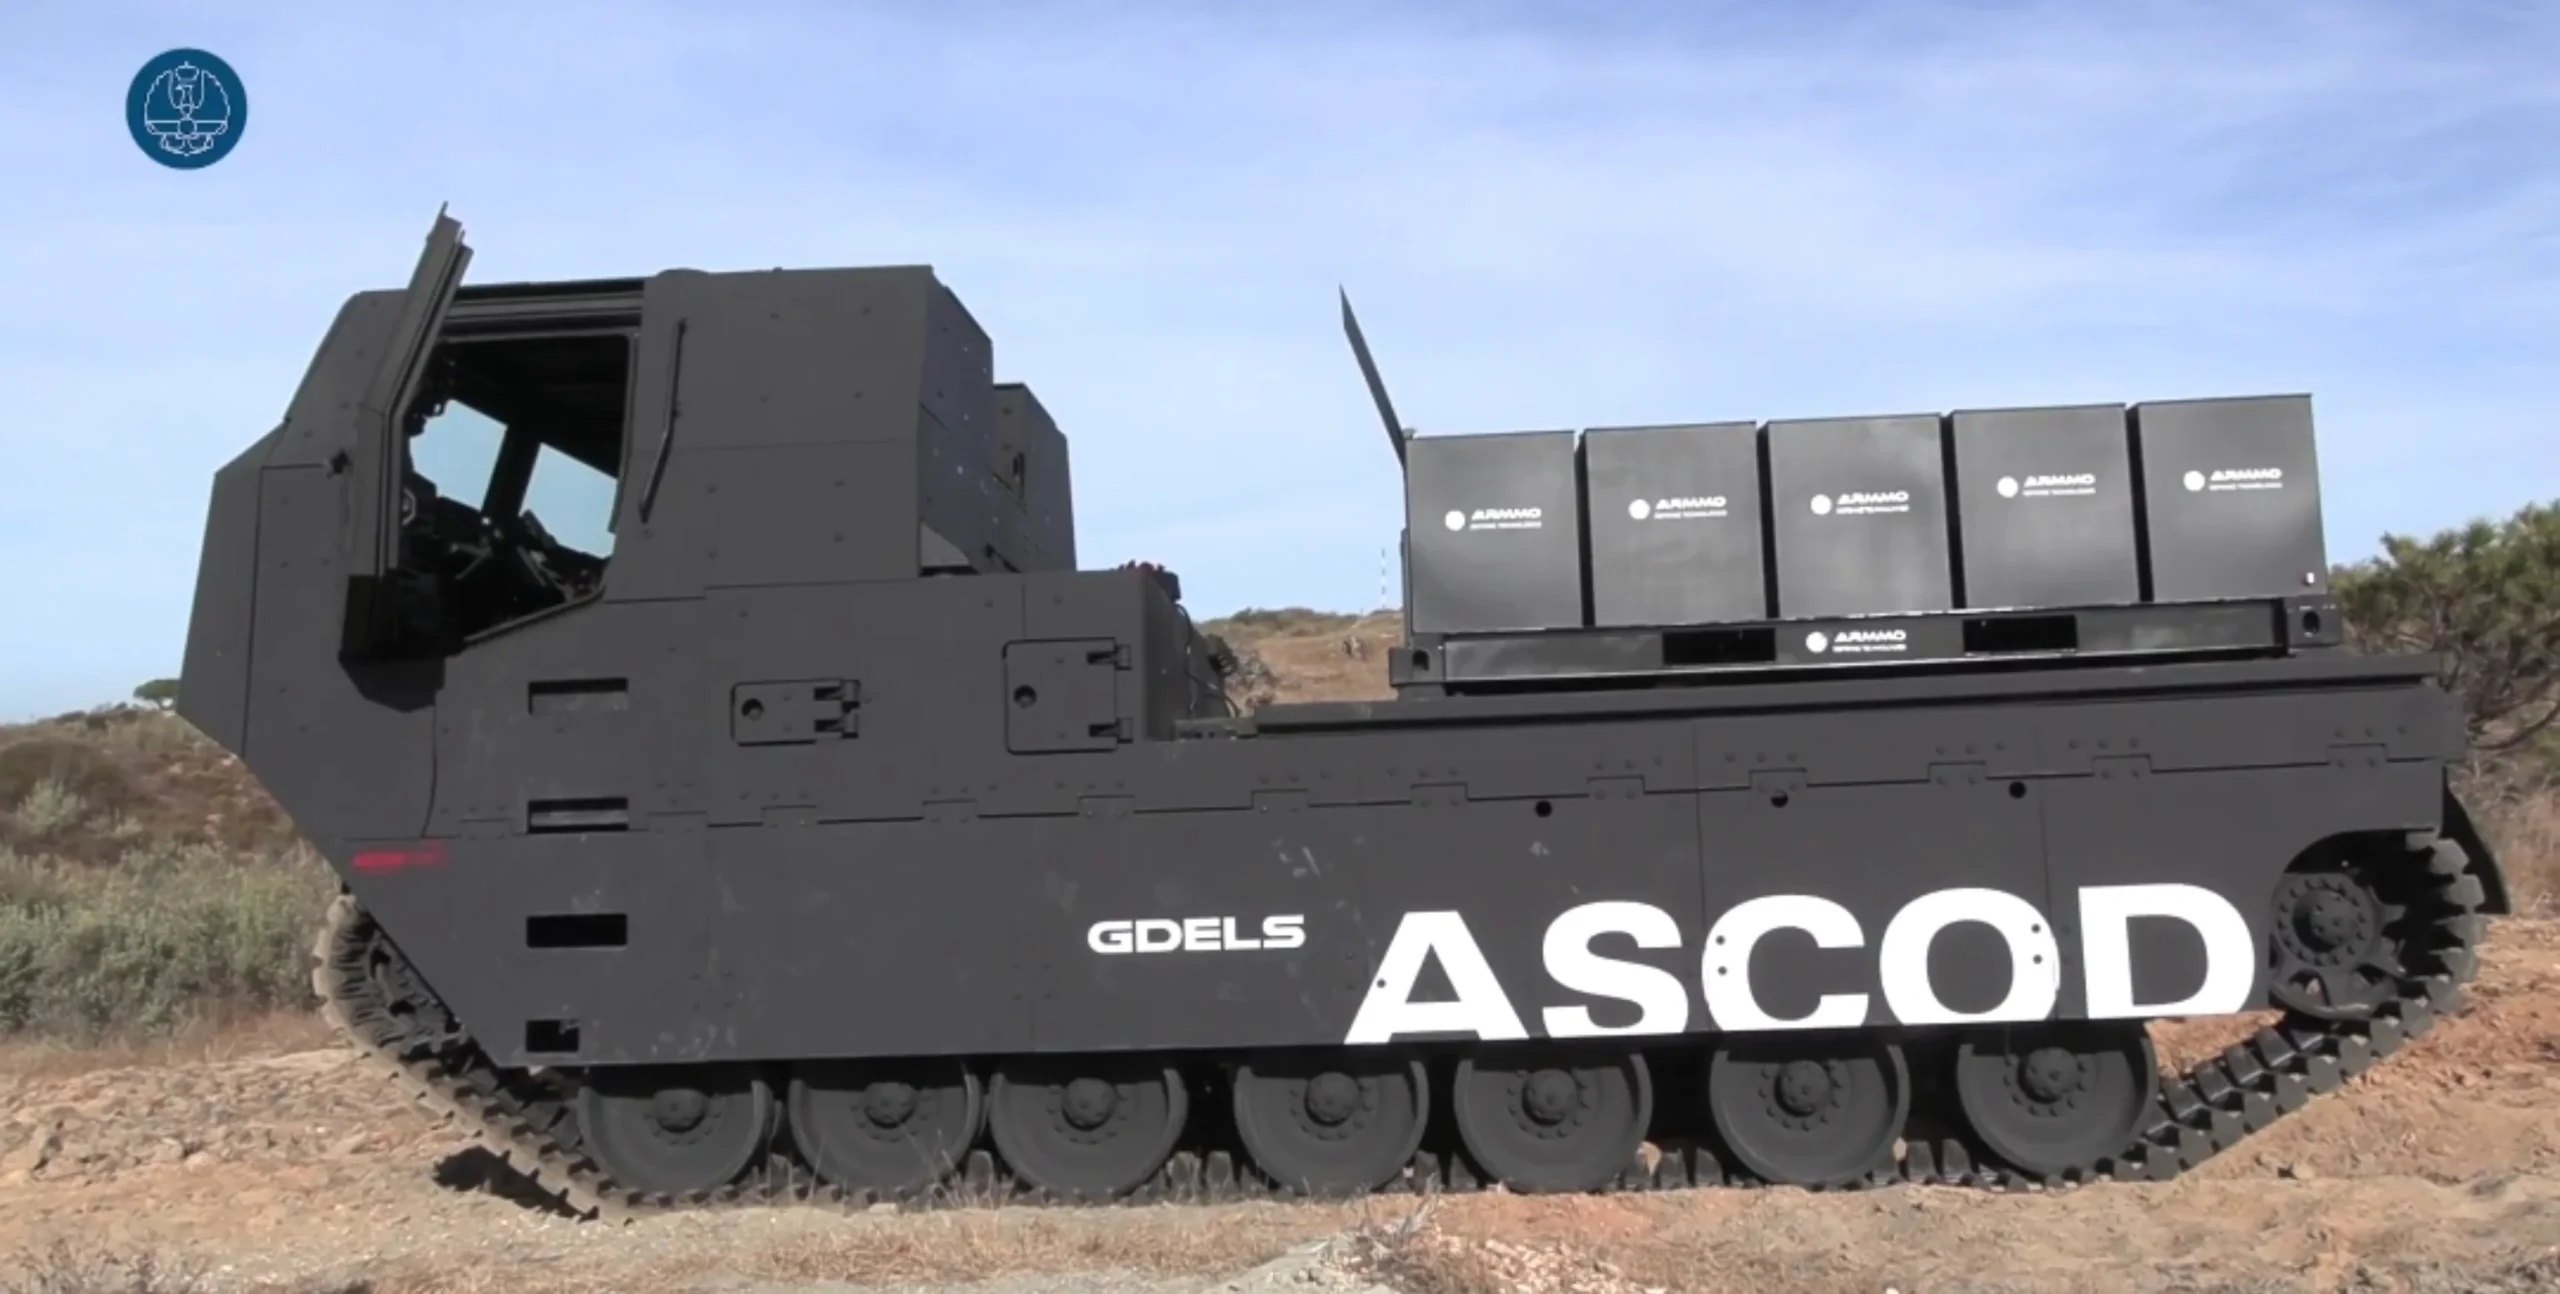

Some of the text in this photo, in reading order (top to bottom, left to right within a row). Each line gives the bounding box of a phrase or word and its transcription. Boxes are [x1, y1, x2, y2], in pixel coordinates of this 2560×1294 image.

[2023, 473, 2096, 488] ARMMO
[2210, 467, 2283, 482] ARMMO
[1655, 496, 1727, 510] ARMMO
[1837, 491, 1910, 505] ARMMO
[1471, 507, 1543, 521] ARMMO
[1834, 629, 1907, 643] ARMMO
[1088, 914, 1306, 954] GDELS
[1344, 882, 2256, 1045] ASCOD
